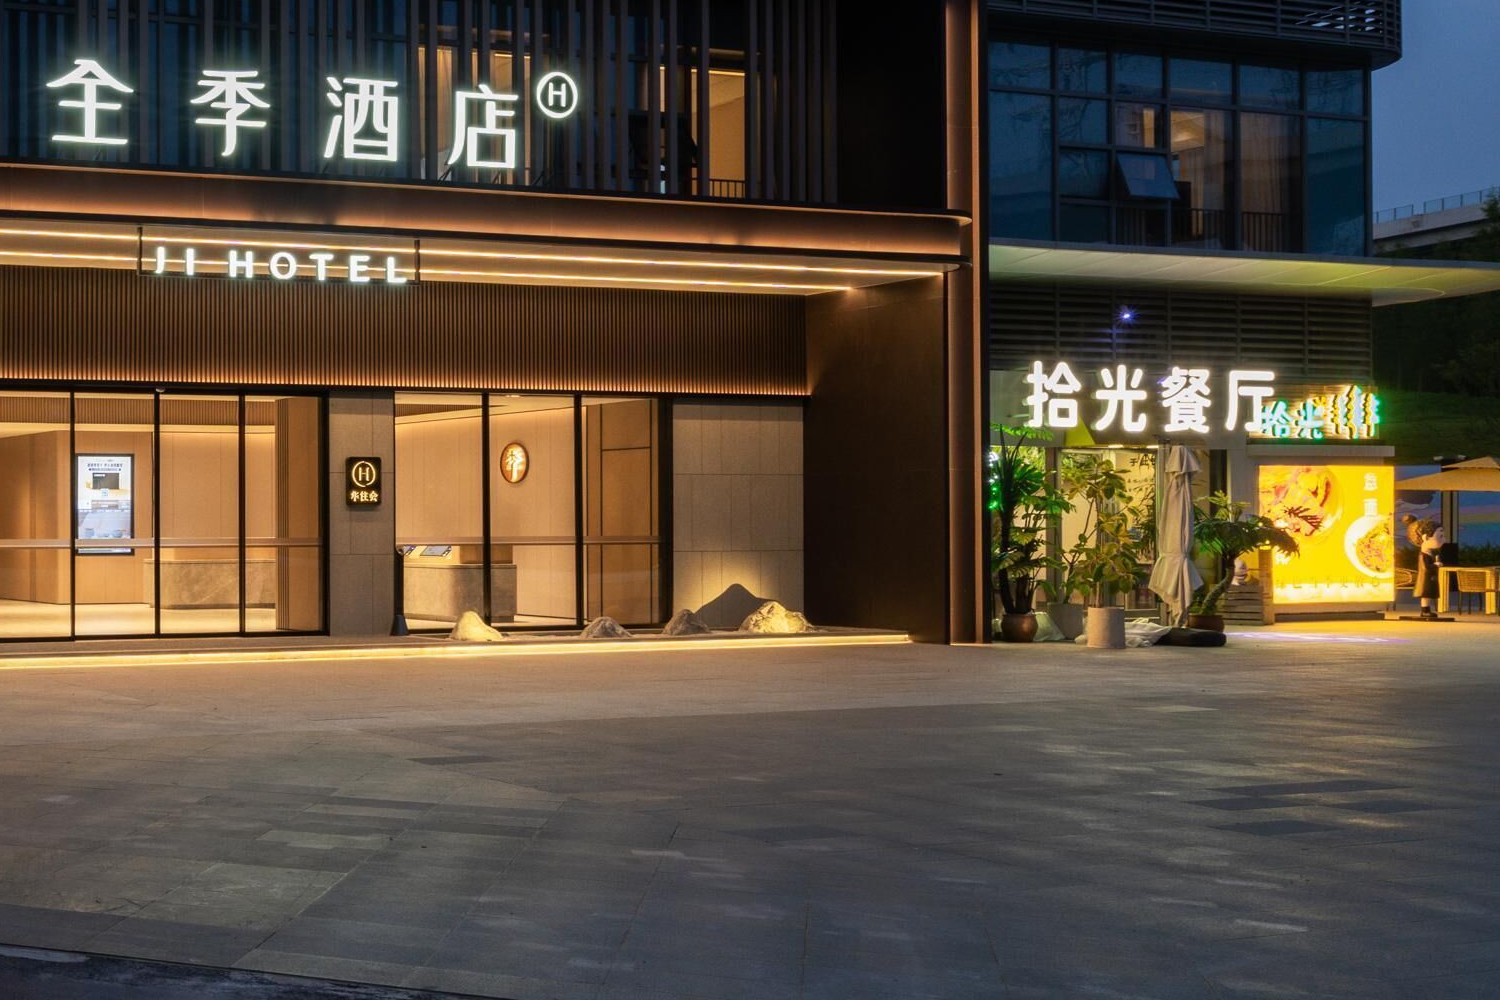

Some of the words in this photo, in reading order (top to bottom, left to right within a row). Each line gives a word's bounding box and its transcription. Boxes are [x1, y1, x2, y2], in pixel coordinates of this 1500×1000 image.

[46, 58, 519, 169] 全季酒店
[155, 246, 195, 276] JI
[228, 250, 407, 284] HOTEL
[1026, 360, 1276, 434] 拾光餐厅
